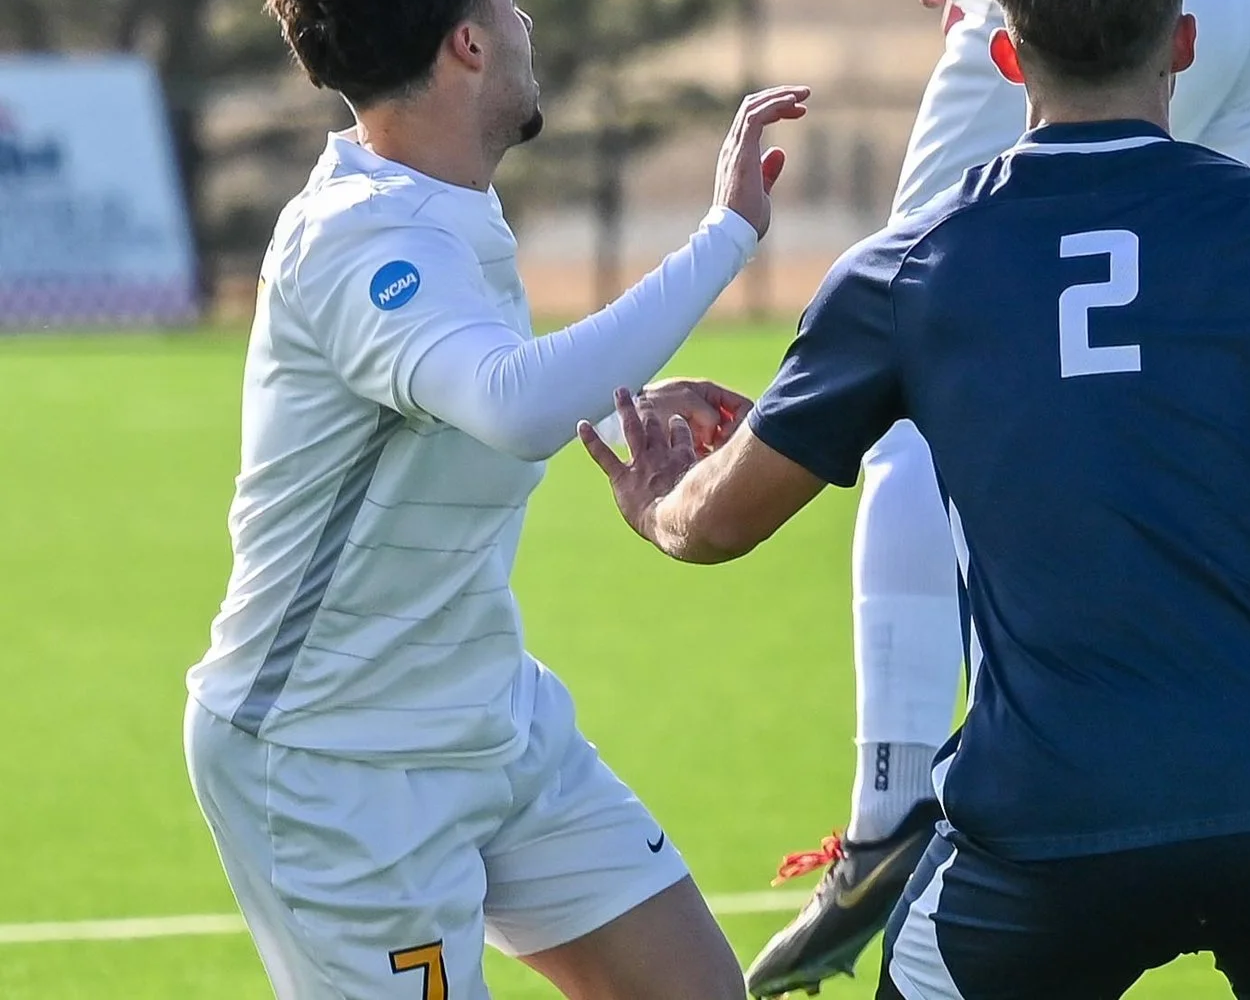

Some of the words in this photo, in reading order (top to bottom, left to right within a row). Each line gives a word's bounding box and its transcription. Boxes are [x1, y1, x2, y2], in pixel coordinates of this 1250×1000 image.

[378, 272, 417, 305] NCAA
[1058, 229, 1142, 378] 2
[388, 938, 448, 1000] 7
